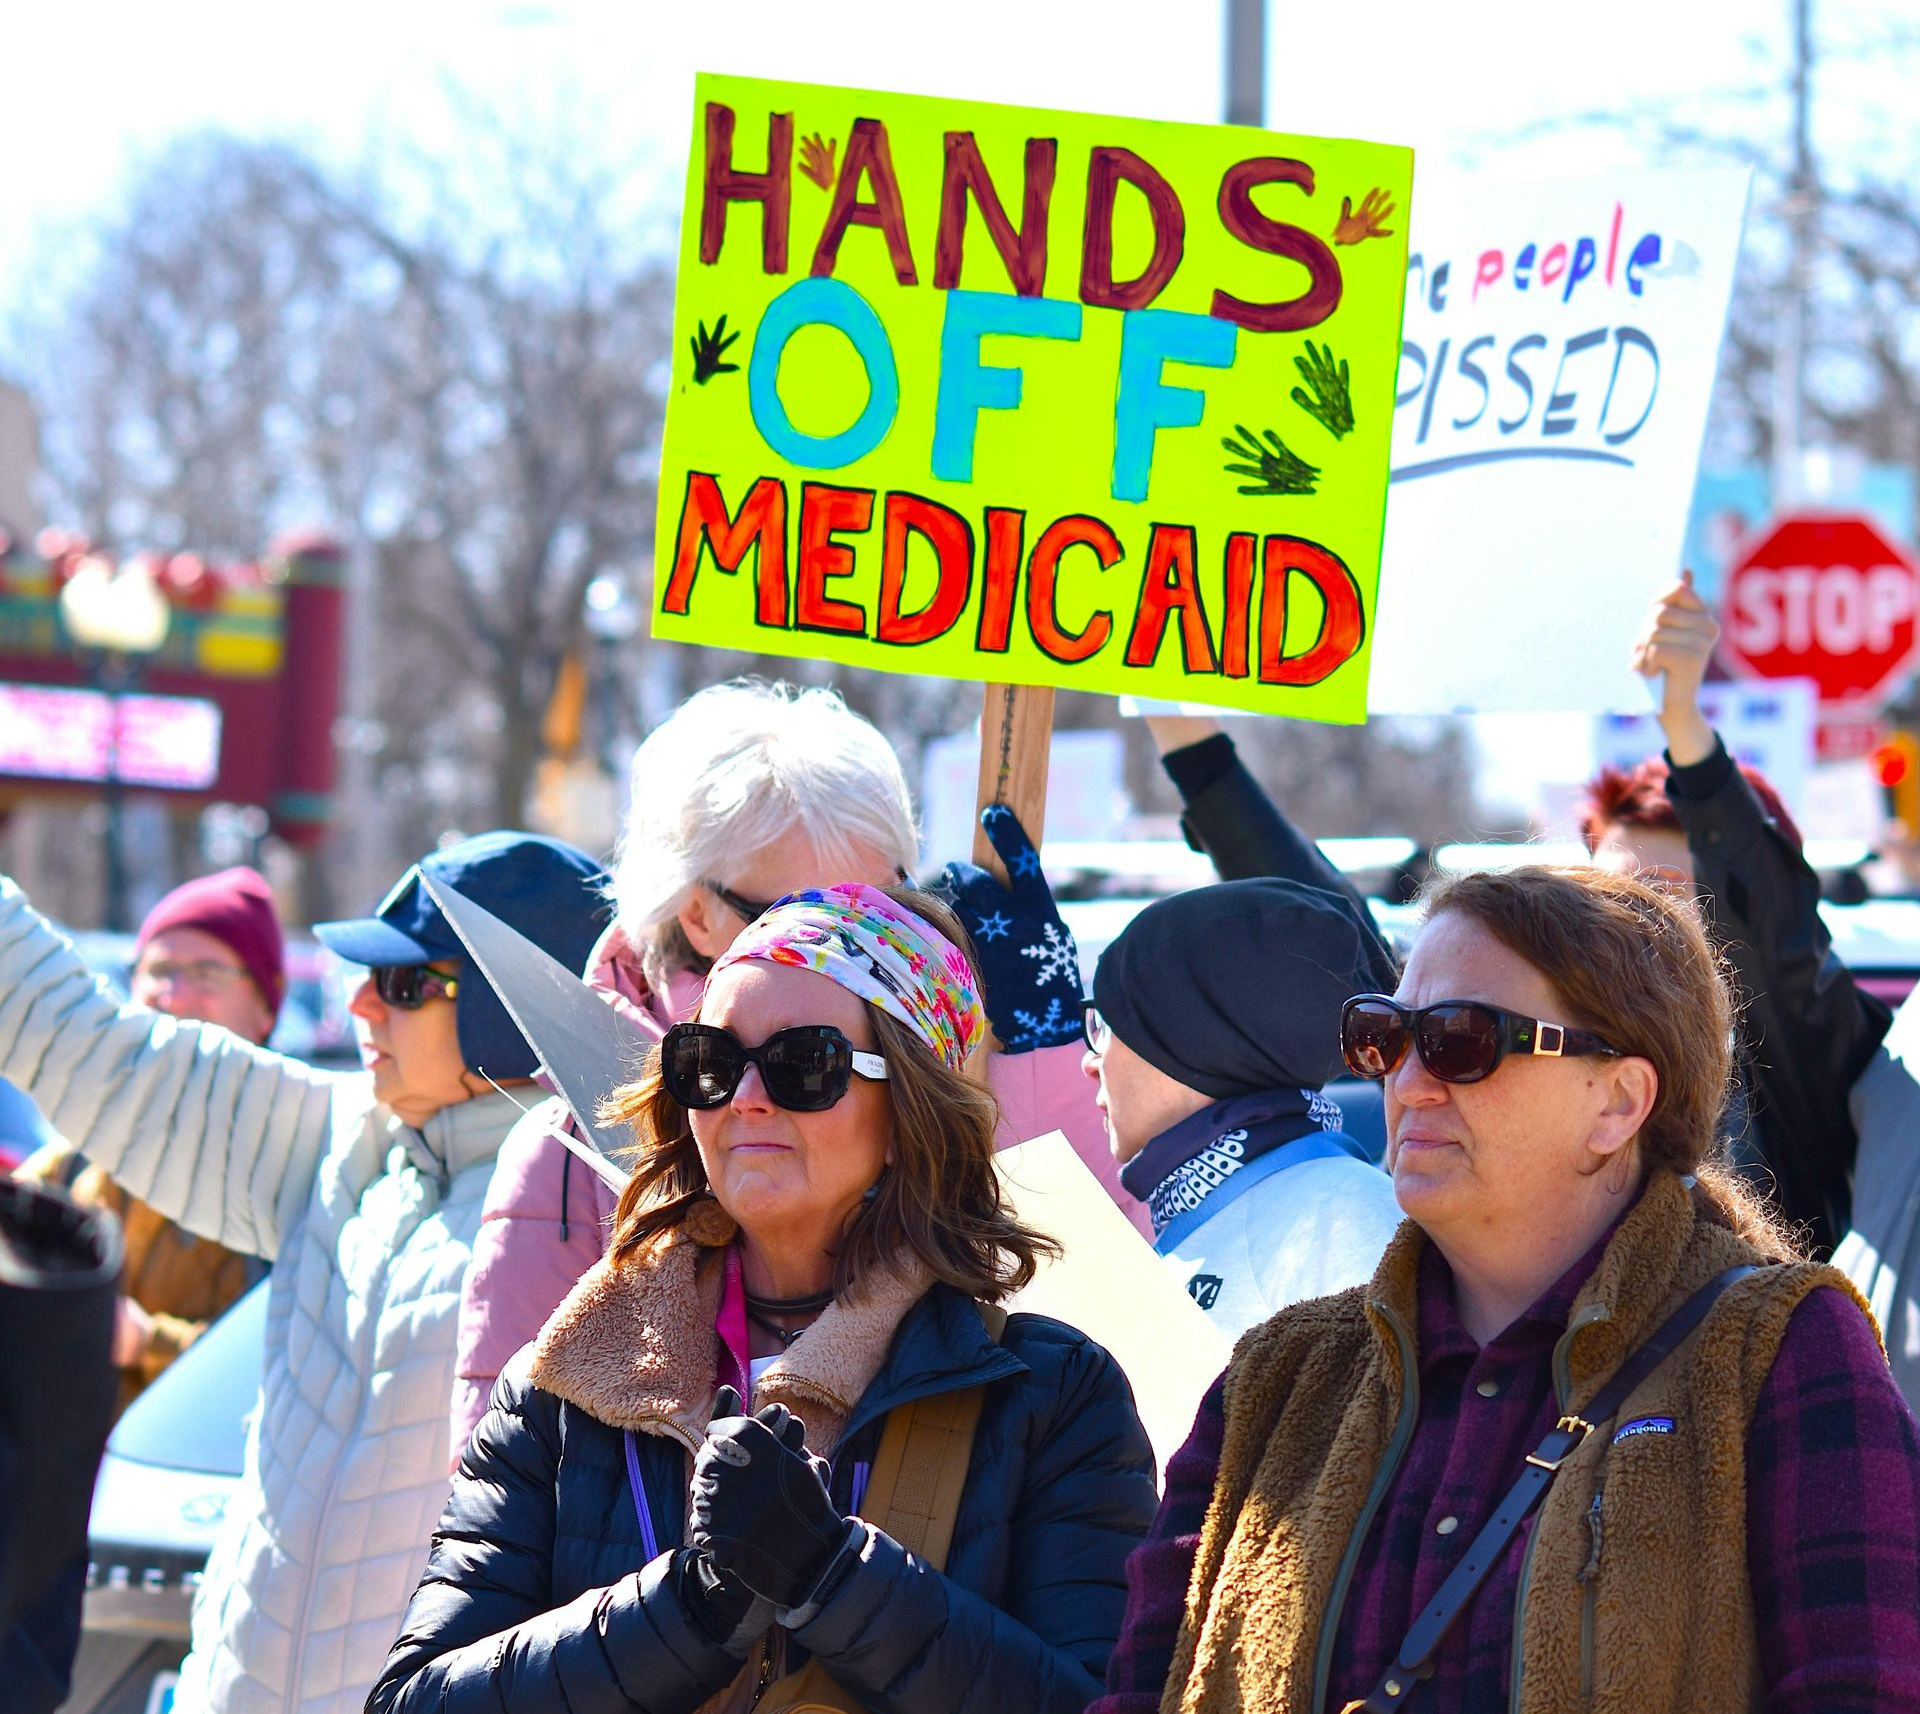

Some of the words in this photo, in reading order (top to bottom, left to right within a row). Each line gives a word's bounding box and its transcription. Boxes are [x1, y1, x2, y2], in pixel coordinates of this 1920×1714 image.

[700, 102, 1344, 333] HANDS
[1472, 200, 1662, 304] people
[748, 276, 1239, 504] OFF
[661, 470, 1366, 686] MEDICAID
[1736, 564, 1914, 656] STOP
[1613, 1425, 1668, 1445] patagonia
